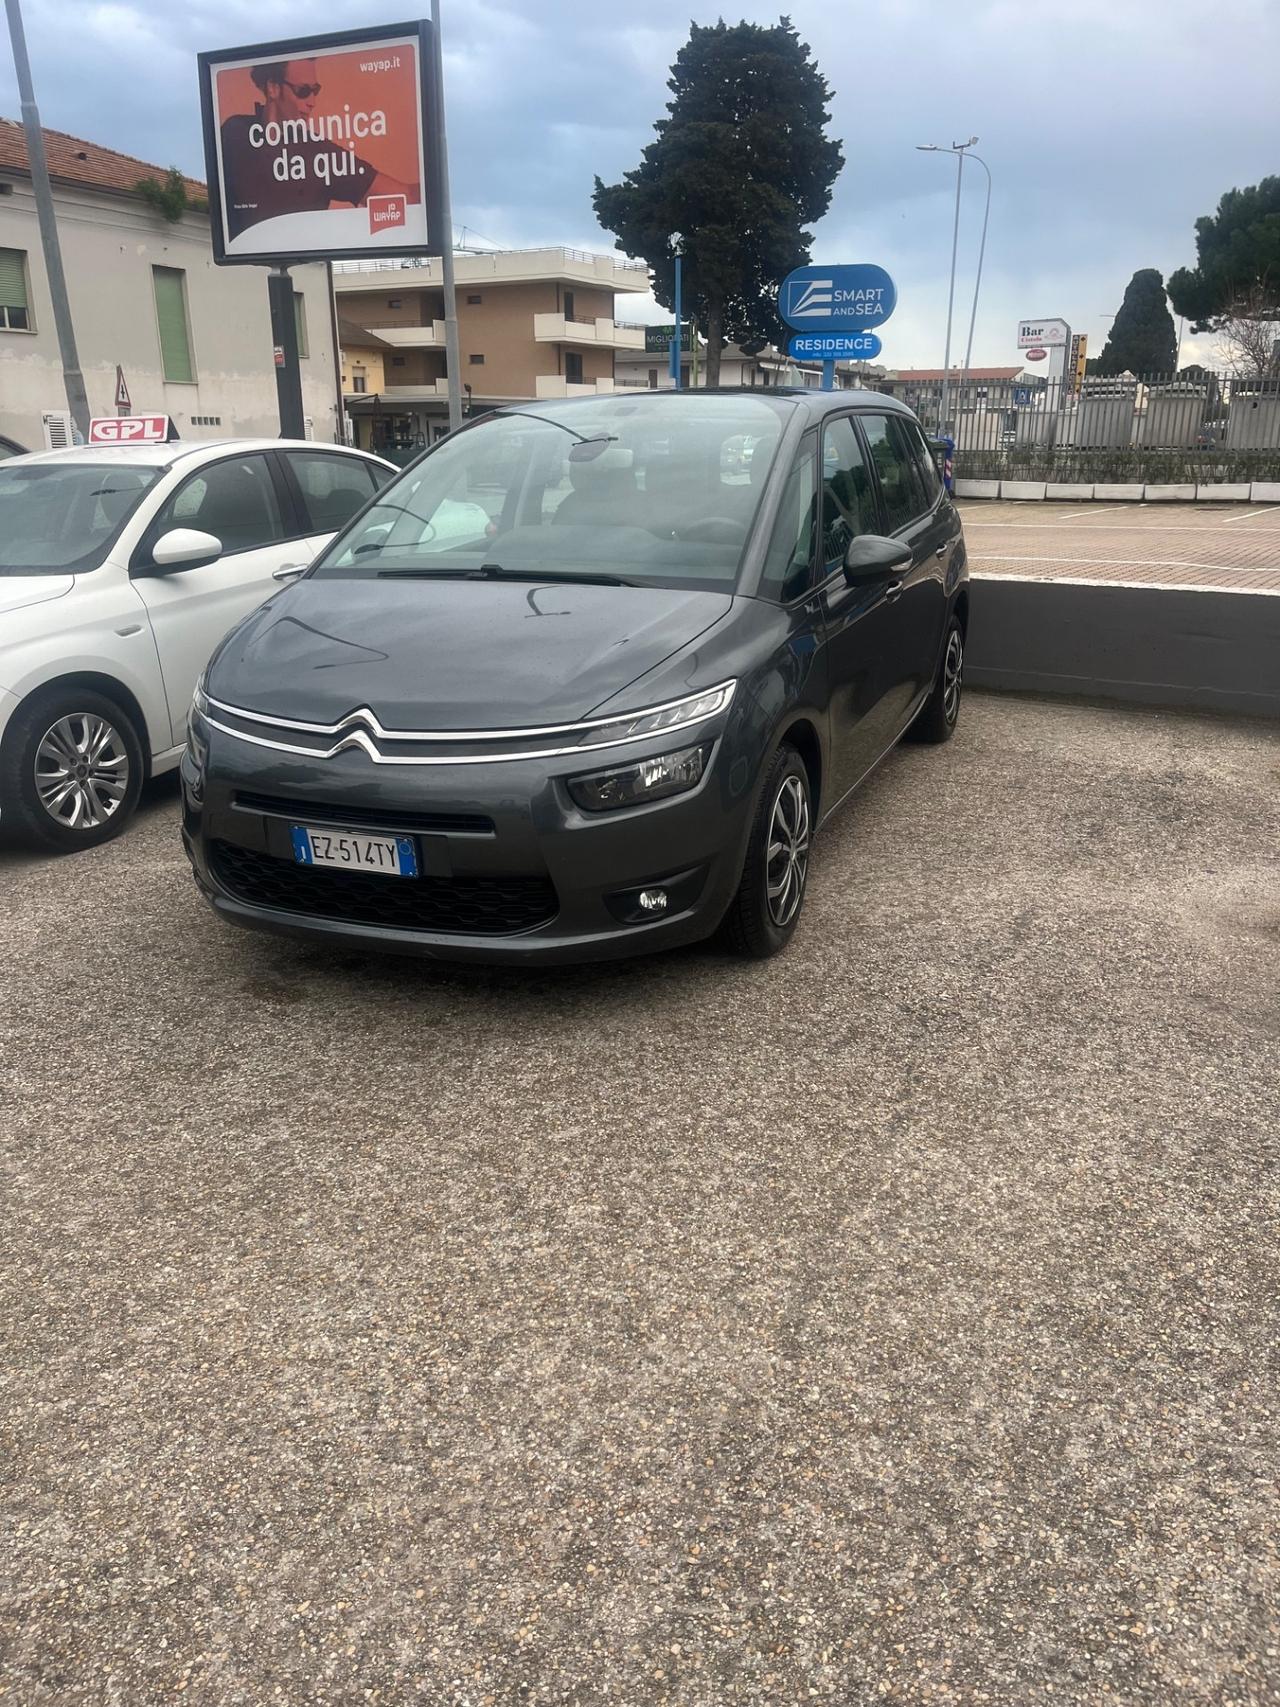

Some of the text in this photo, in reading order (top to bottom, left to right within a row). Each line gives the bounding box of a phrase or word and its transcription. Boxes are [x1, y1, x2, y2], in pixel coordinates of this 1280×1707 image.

[359, 56, 401, 73] wayap.it
[249, 104, 387, 148] comunica
[273, 141, 365, 186] da qui.
[834, 288, 885, 302] SMART
[833, 303, 884, 316] AND SEA
[647, 334, 689, 343] MIGLIOATI
[1022, 326, 1044, 337] Bar
[795, 338, 873, 351] RESIDENCE
[93, 419, 162, 440] GPL
